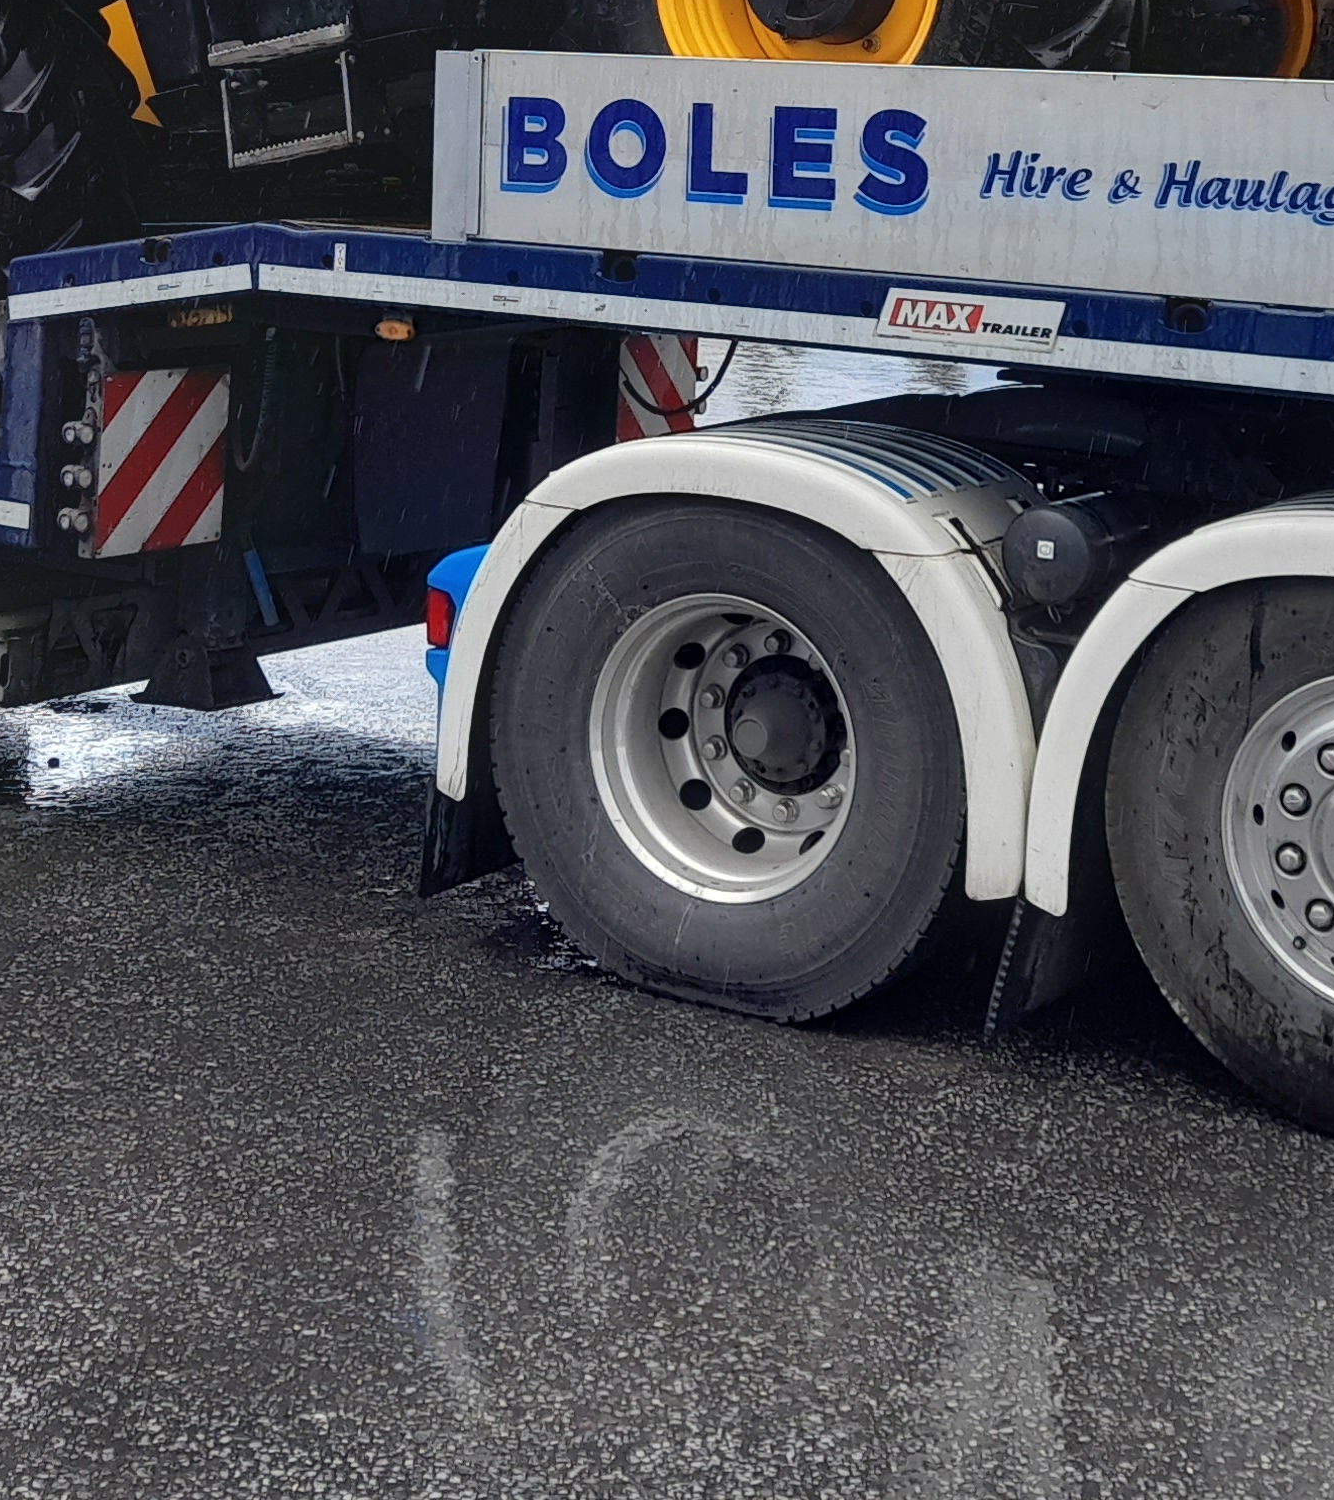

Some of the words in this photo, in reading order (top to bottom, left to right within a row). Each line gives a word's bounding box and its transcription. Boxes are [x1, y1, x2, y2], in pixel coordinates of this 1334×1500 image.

[500, 96, 931, 217] BOLES
[980, 150, 1093, 201] Hire
[1107, 169, 1143, 204] &
[896, 300, 975, 332] MAX
[981, 322, 1053, 339] TRAILER
